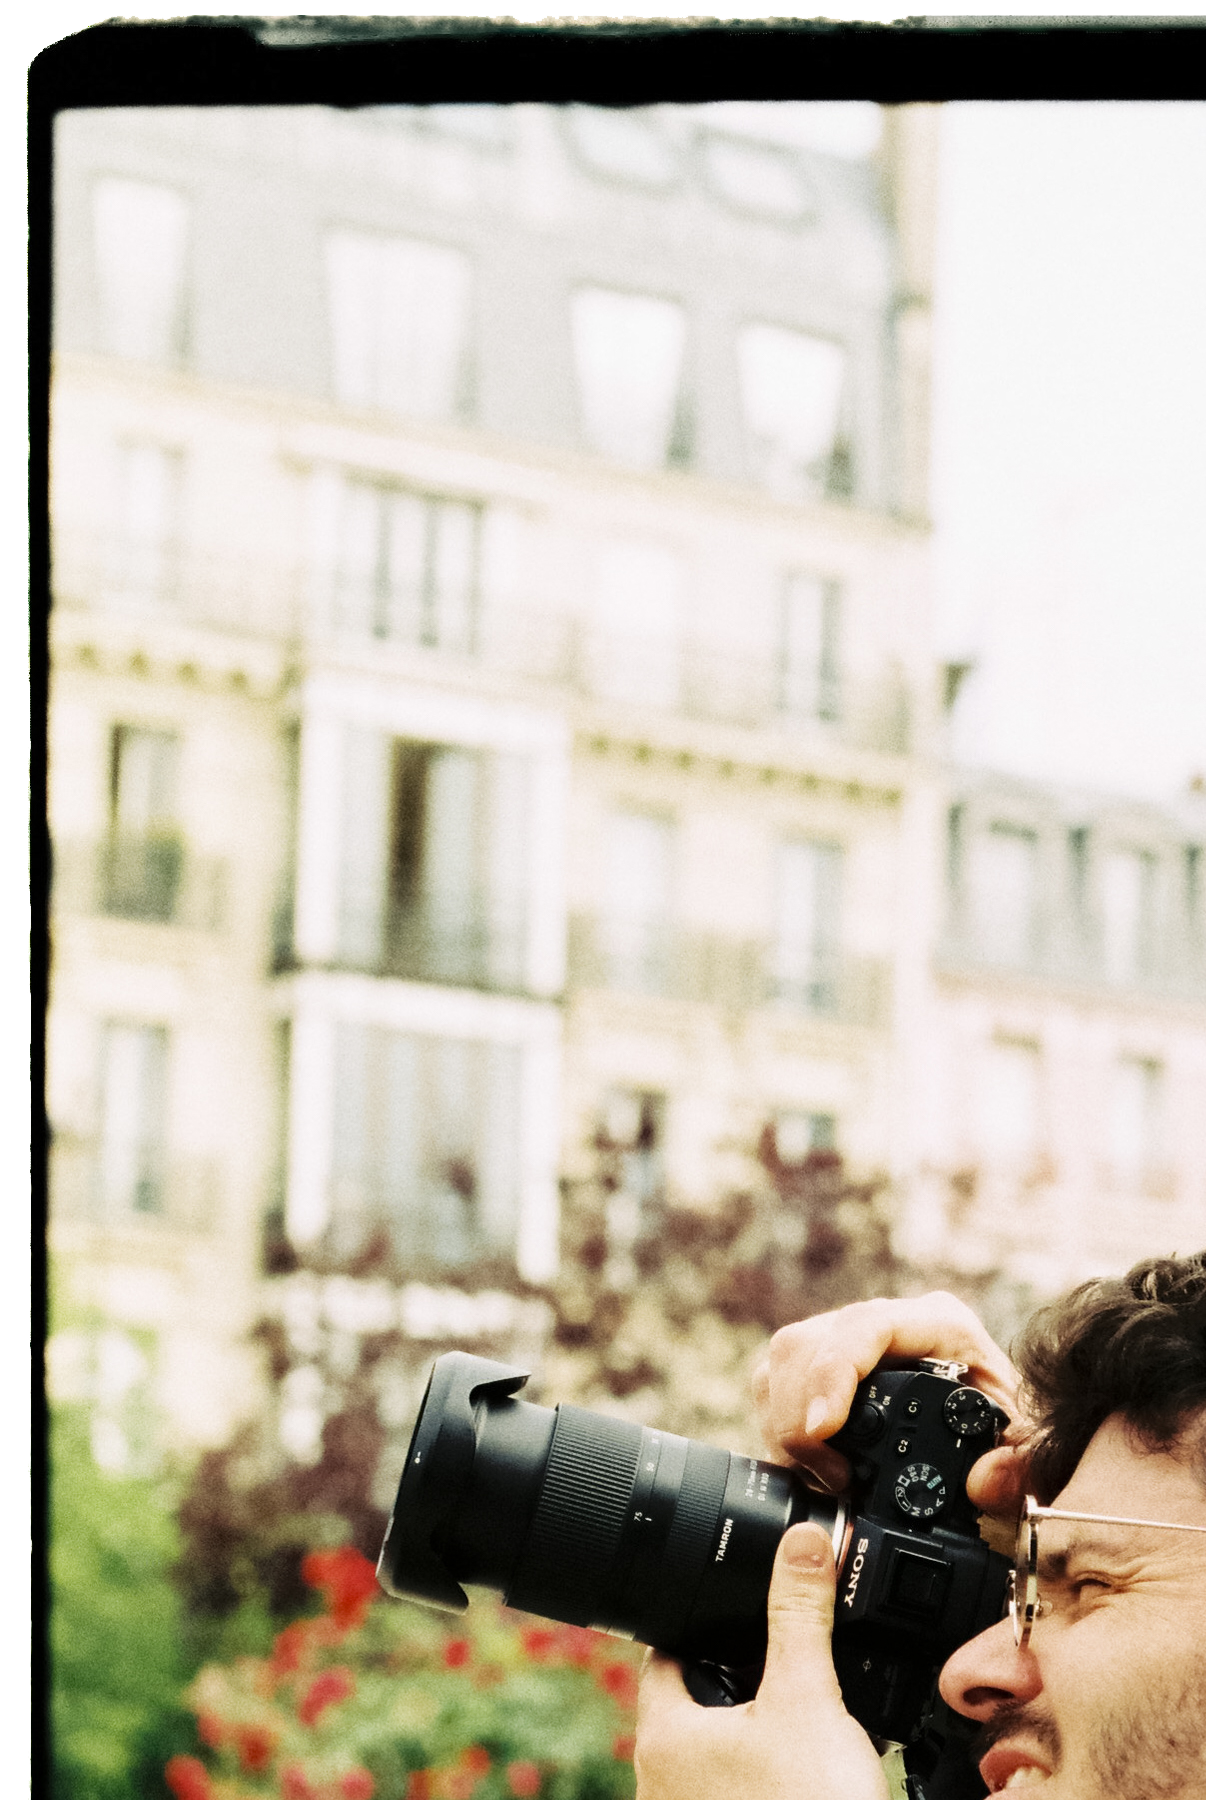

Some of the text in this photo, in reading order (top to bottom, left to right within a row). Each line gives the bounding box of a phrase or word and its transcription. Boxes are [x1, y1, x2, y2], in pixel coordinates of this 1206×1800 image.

[869, 1385, 877, 1399] OFF
[882, 1395, 892, 1406] ON
[908, 1401, 918, 1413] C1
[898, 1440, 909, 1453] C2
[939, 1486, 946, 1495] P
[936, 1498, 944, 1507] A
[634, 1511, 643, 1522] 75
[911, 1506, 921, 1517] M
[924, 1507, 934, 1516] S
[715, 1518, 734, 1562] TAMRON
[844, 1538, 869, 1608] SONY
